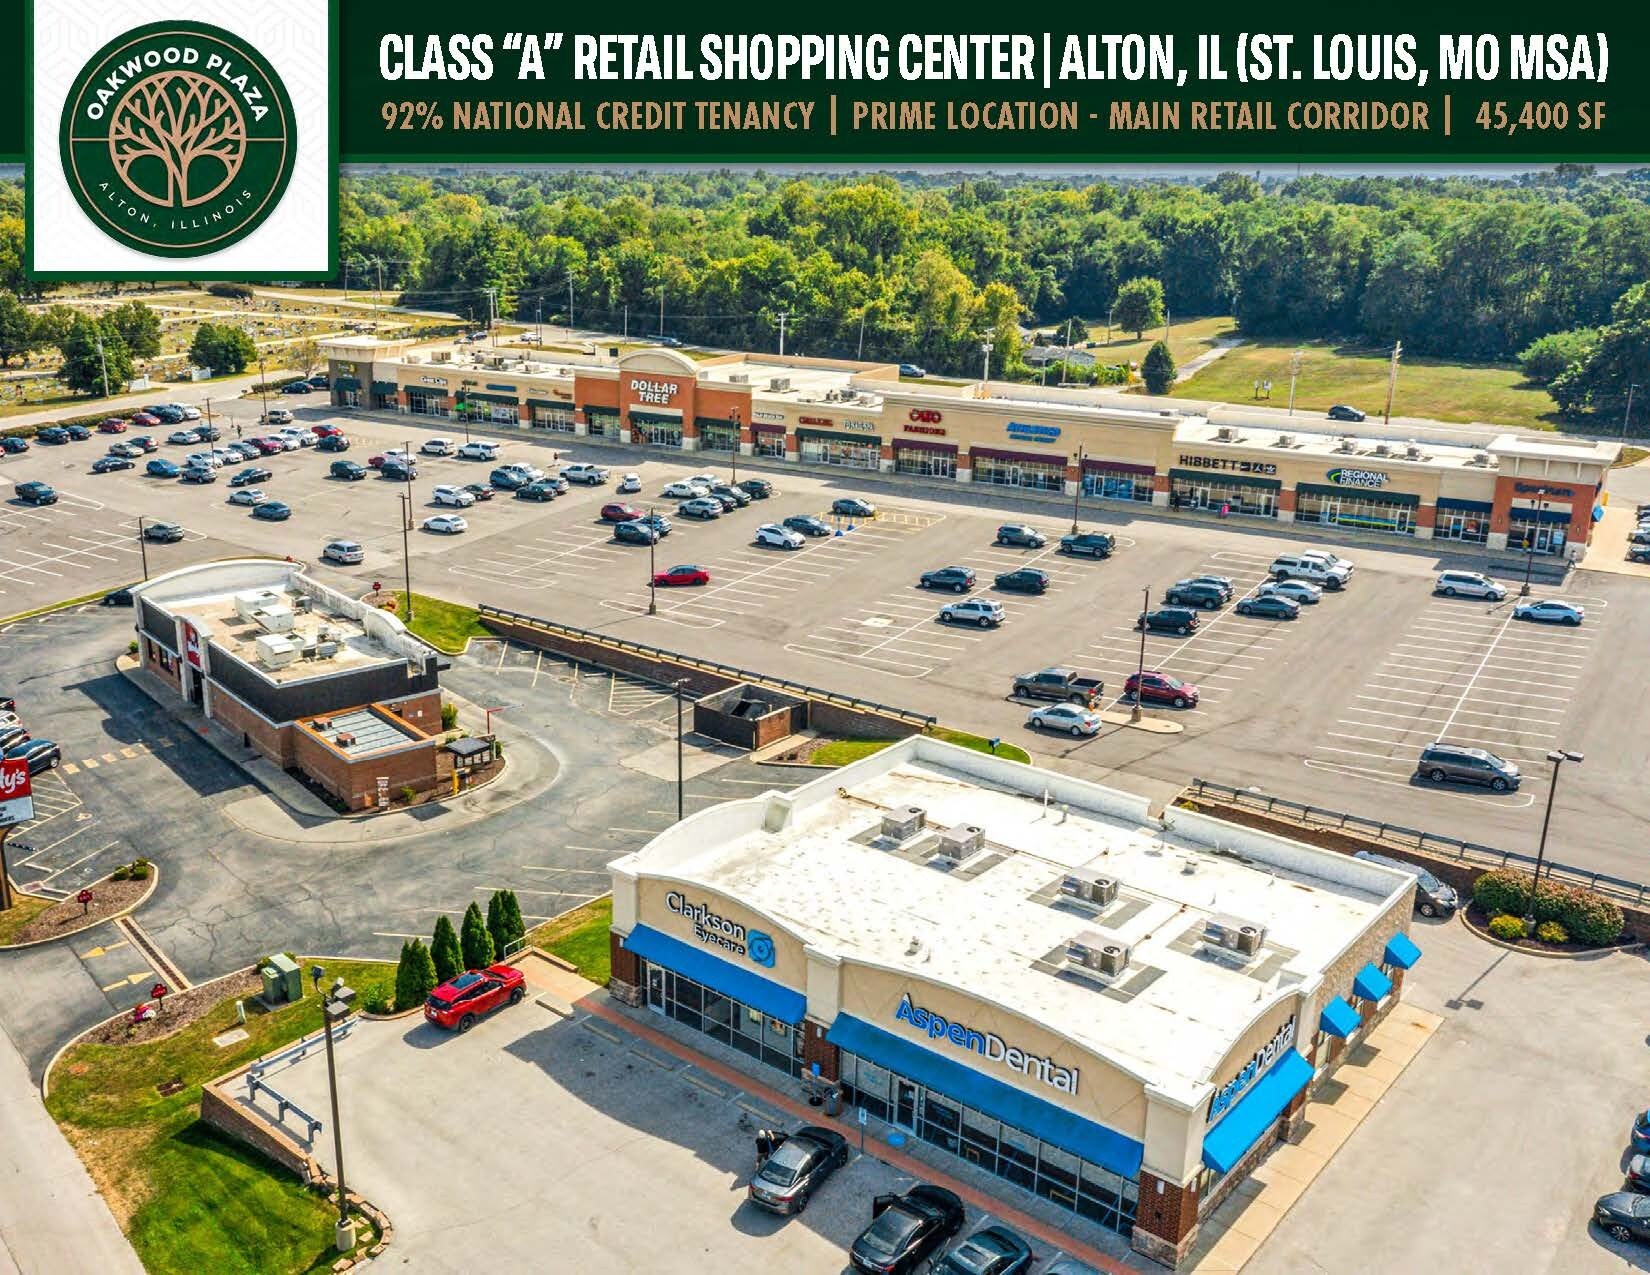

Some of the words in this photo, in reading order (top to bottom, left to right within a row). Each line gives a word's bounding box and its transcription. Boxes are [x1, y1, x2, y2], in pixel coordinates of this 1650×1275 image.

[631, 380, 678, 395] DOLLAR
[639, 391, 669, 404] TREE
[1179, 454, 1238, 471] HIBBETT
[1339, 476, 1382, 488] FINANCE
[1340, 469, 1391, 483] REGIONAL
[665, 891, 746, 941] Clarkson
[694, 923, 746, 956] Eyecare
